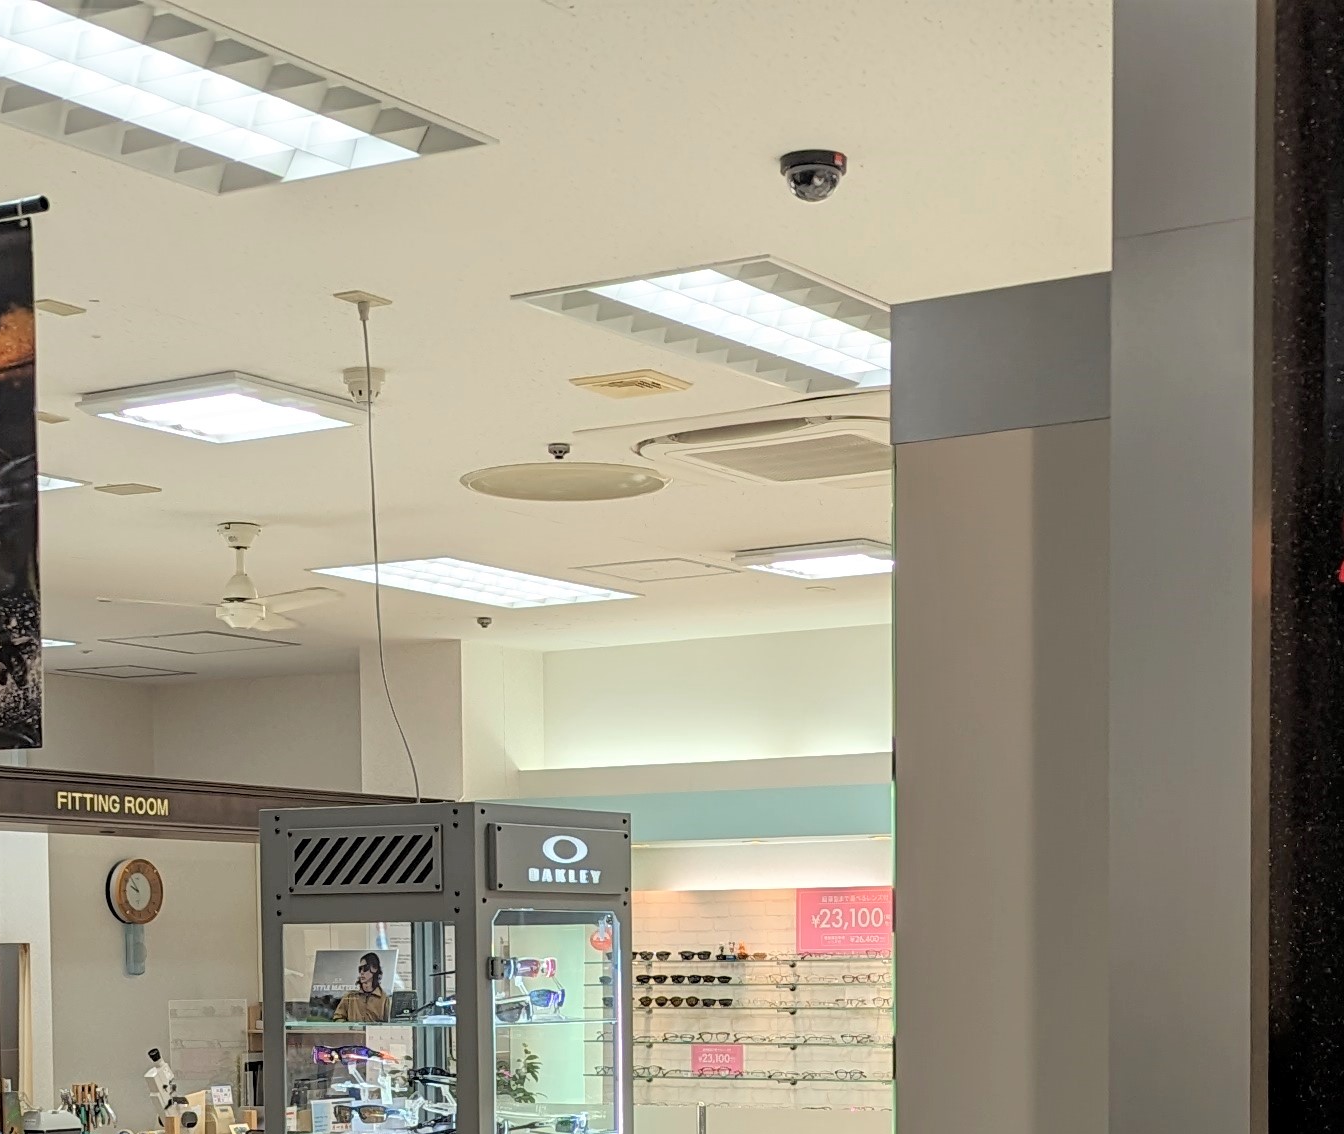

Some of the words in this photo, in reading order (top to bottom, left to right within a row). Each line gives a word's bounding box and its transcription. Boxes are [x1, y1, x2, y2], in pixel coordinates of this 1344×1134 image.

[56, 791, 121, 814] FITTING
[124, 796, 170, 817] ROOM
[528, 867, 602, 884] OAKLEY
[810, 907, 884, 930] ¥23,100
